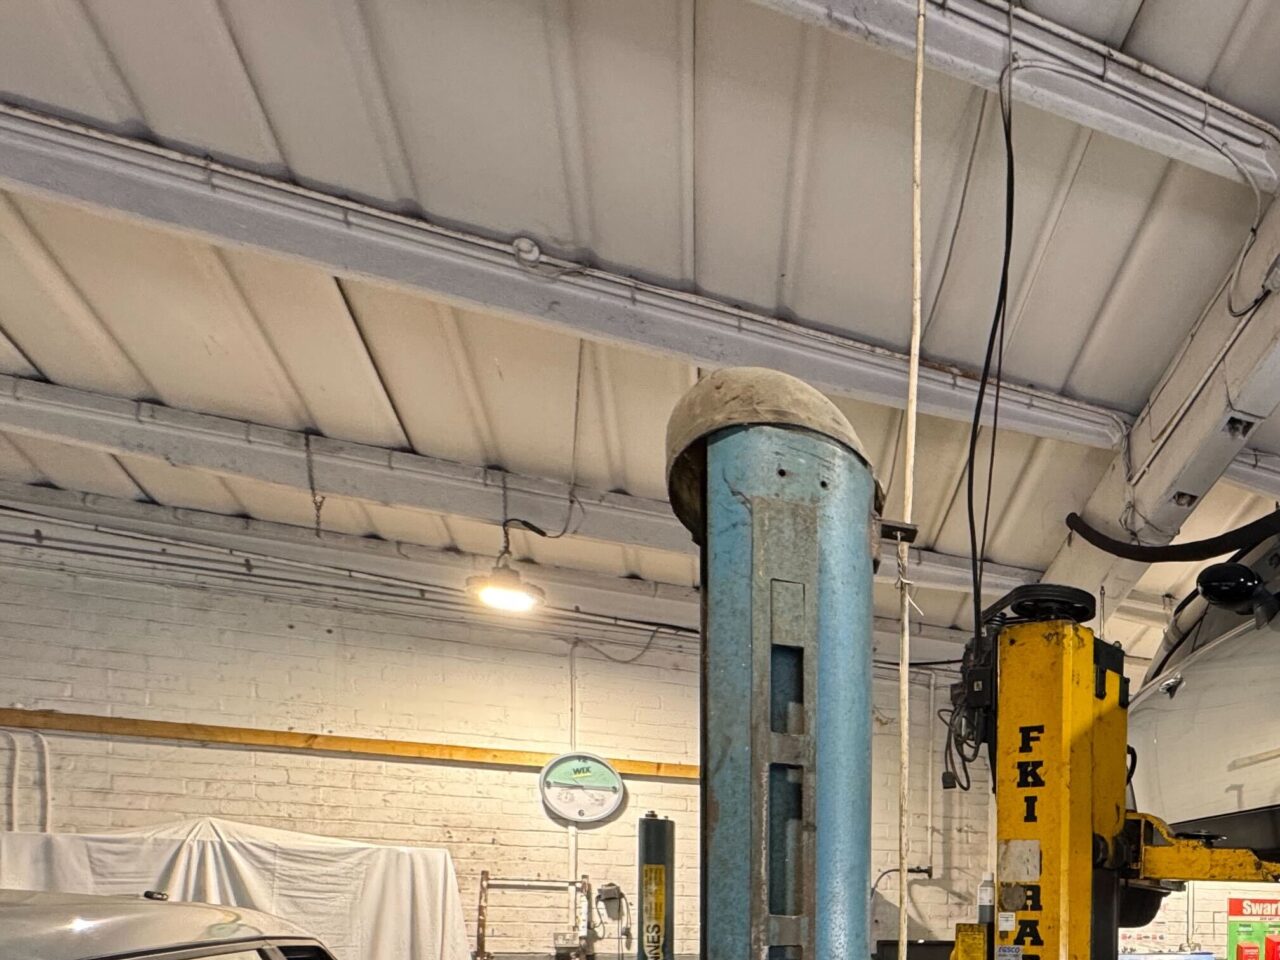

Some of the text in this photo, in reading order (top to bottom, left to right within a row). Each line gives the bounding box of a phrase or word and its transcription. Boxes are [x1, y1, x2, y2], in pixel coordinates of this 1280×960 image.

[572, 766, 592, 775] WIX
[1016, 724, 1046, 823] FKI
[577, 809, 585, 817] 6
